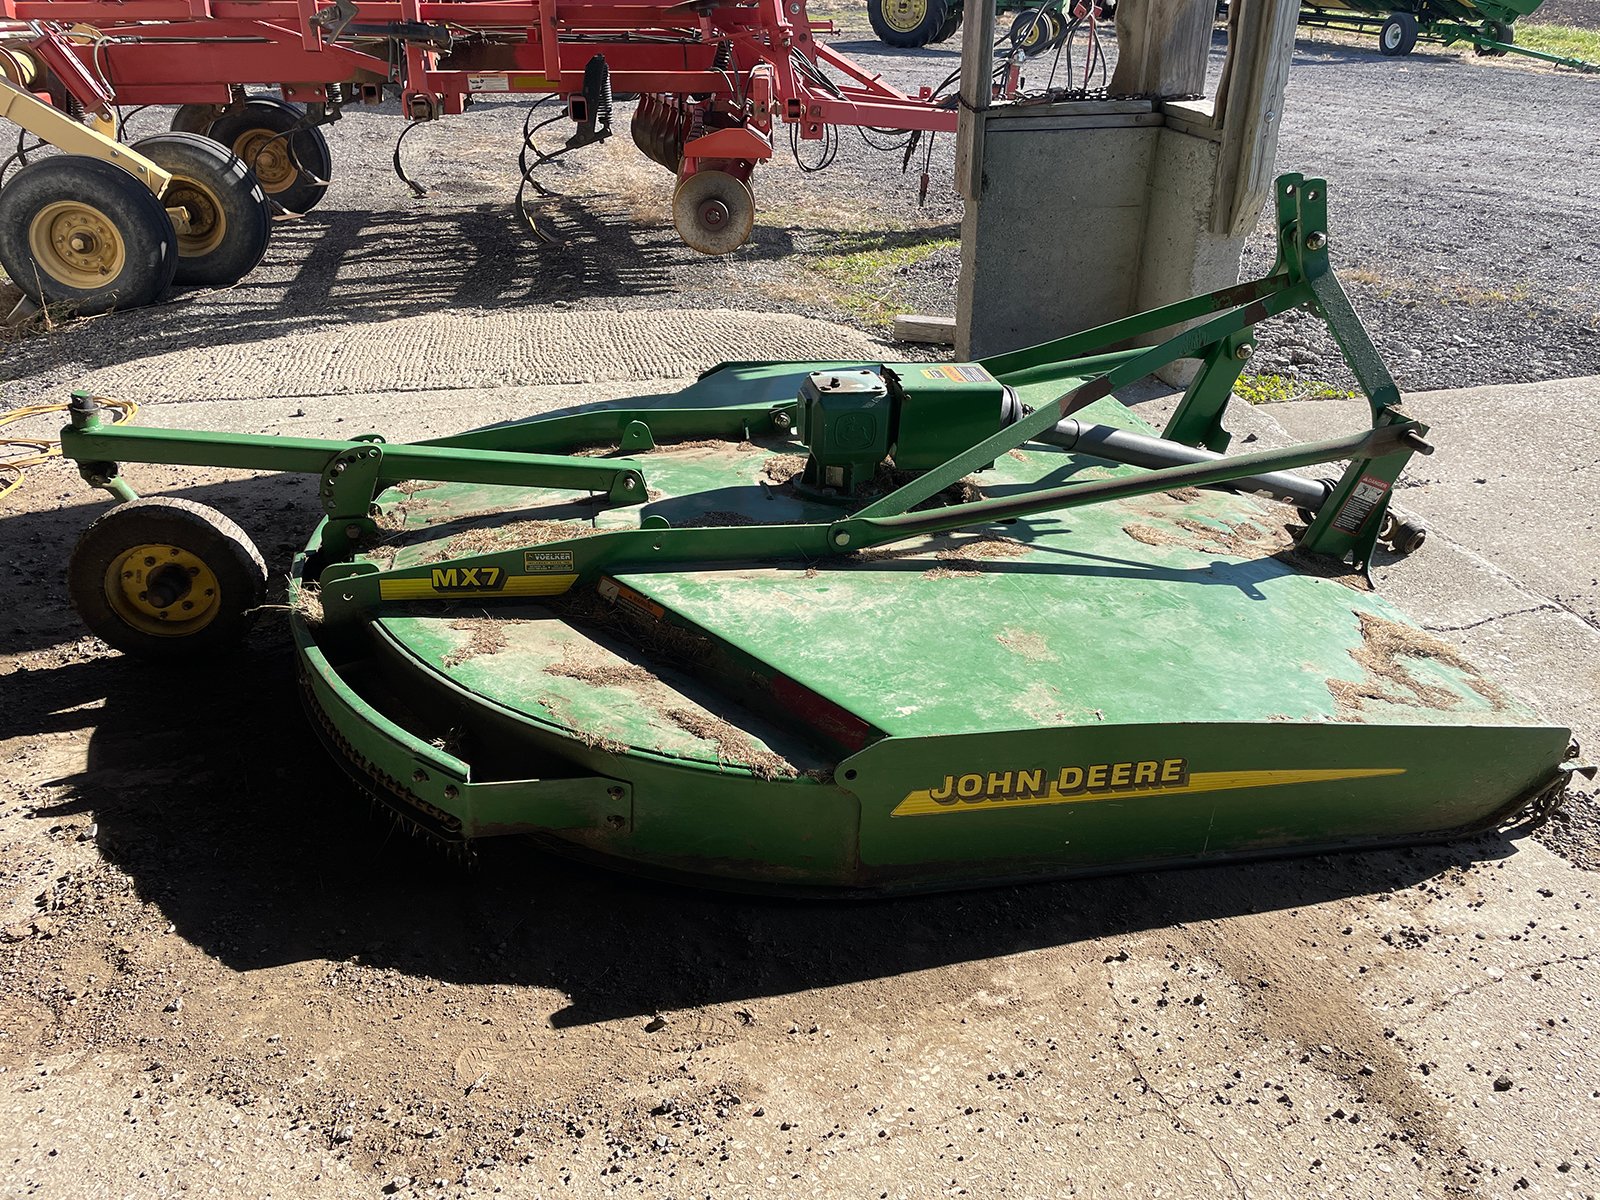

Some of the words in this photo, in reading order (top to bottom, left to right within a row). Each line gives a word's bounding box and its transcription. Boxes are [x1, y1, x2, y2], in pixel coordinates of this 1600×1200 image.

[431, 567, 502, 588] MX7
[929, 769, 1045, 802] JOHN
[1057, 758, 1186, 792] DEERE
